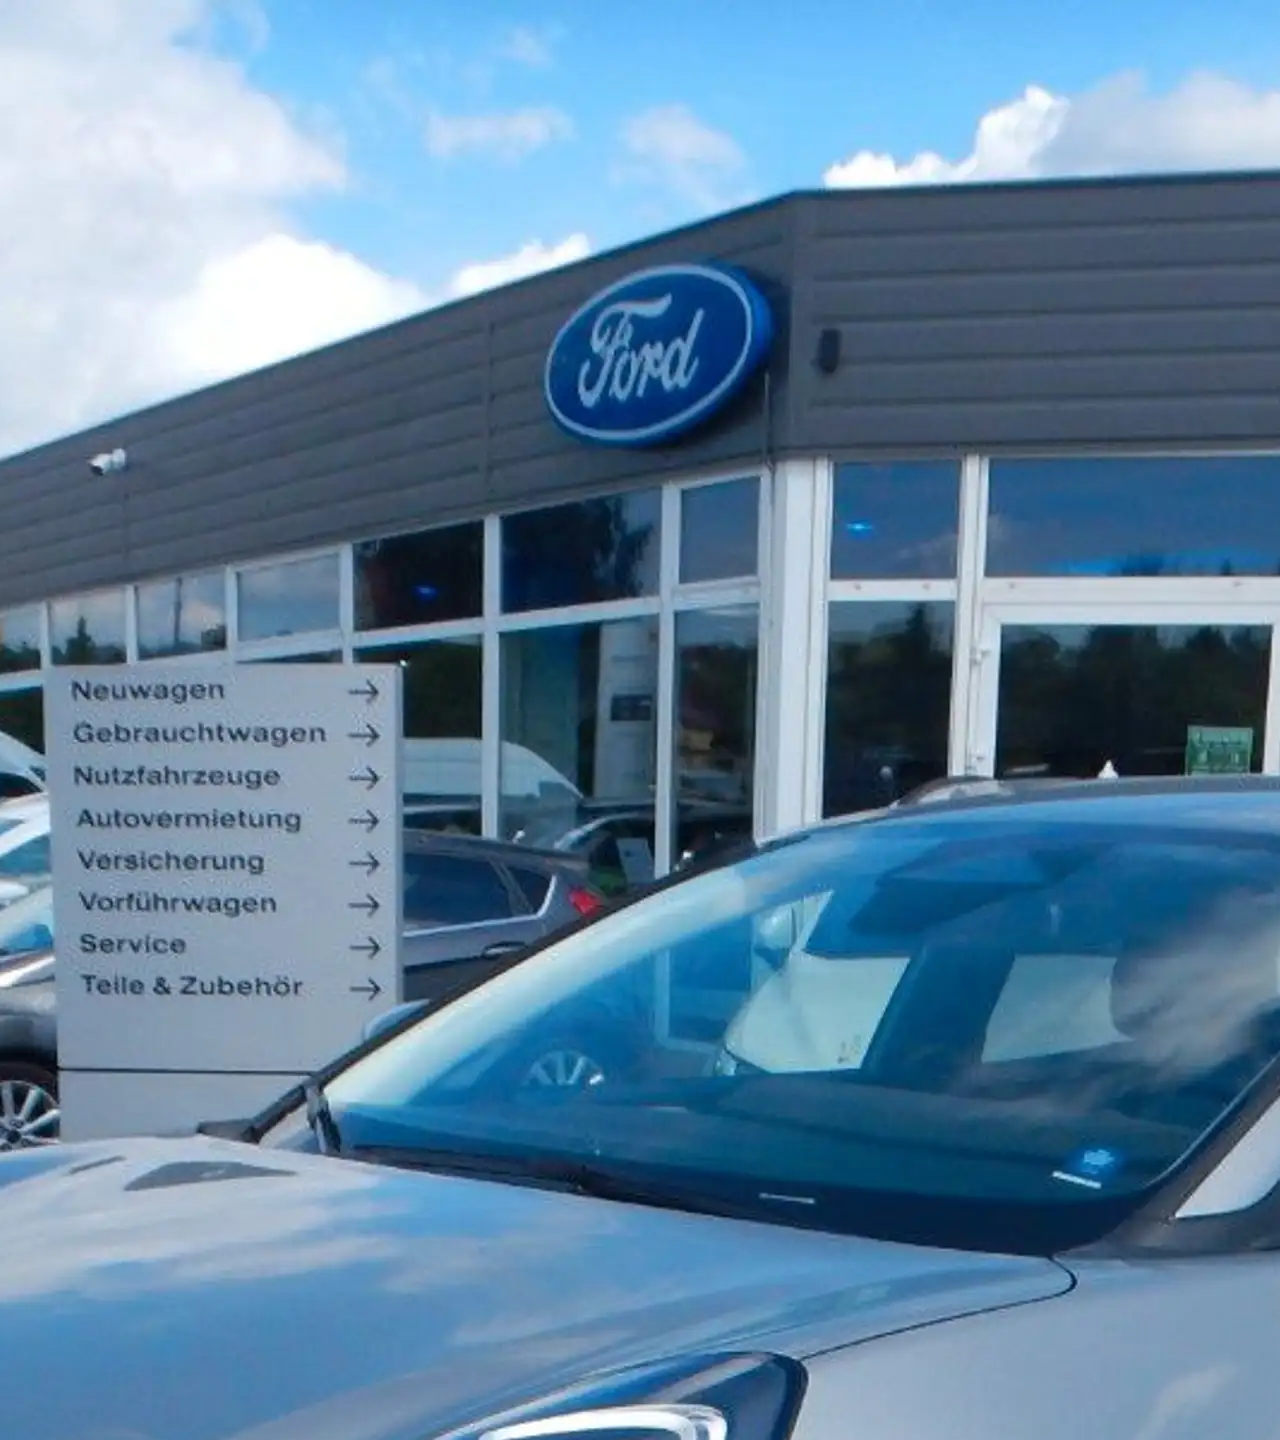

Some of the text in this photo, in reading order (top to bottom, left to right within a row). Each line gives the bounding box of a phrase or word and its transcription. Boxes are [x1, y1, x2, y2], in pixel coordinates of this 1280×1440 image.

[577, 291, 705, 407] Ford
[70, 679, 226, 704] Neuwagen
[72, 721, 328, 746] Gebrauchtwagen
[73, 765, 282, 791] Nutzfahrzeuge
[76, 807, 303, 834] Autovermietung
[77, 851, 266, 876] Versicherung
[78, 891, 278, 918] Vorführwagen
[79, 933, 187, 955] Service
[80, 974, 304, 998] Teile & Zubehör
